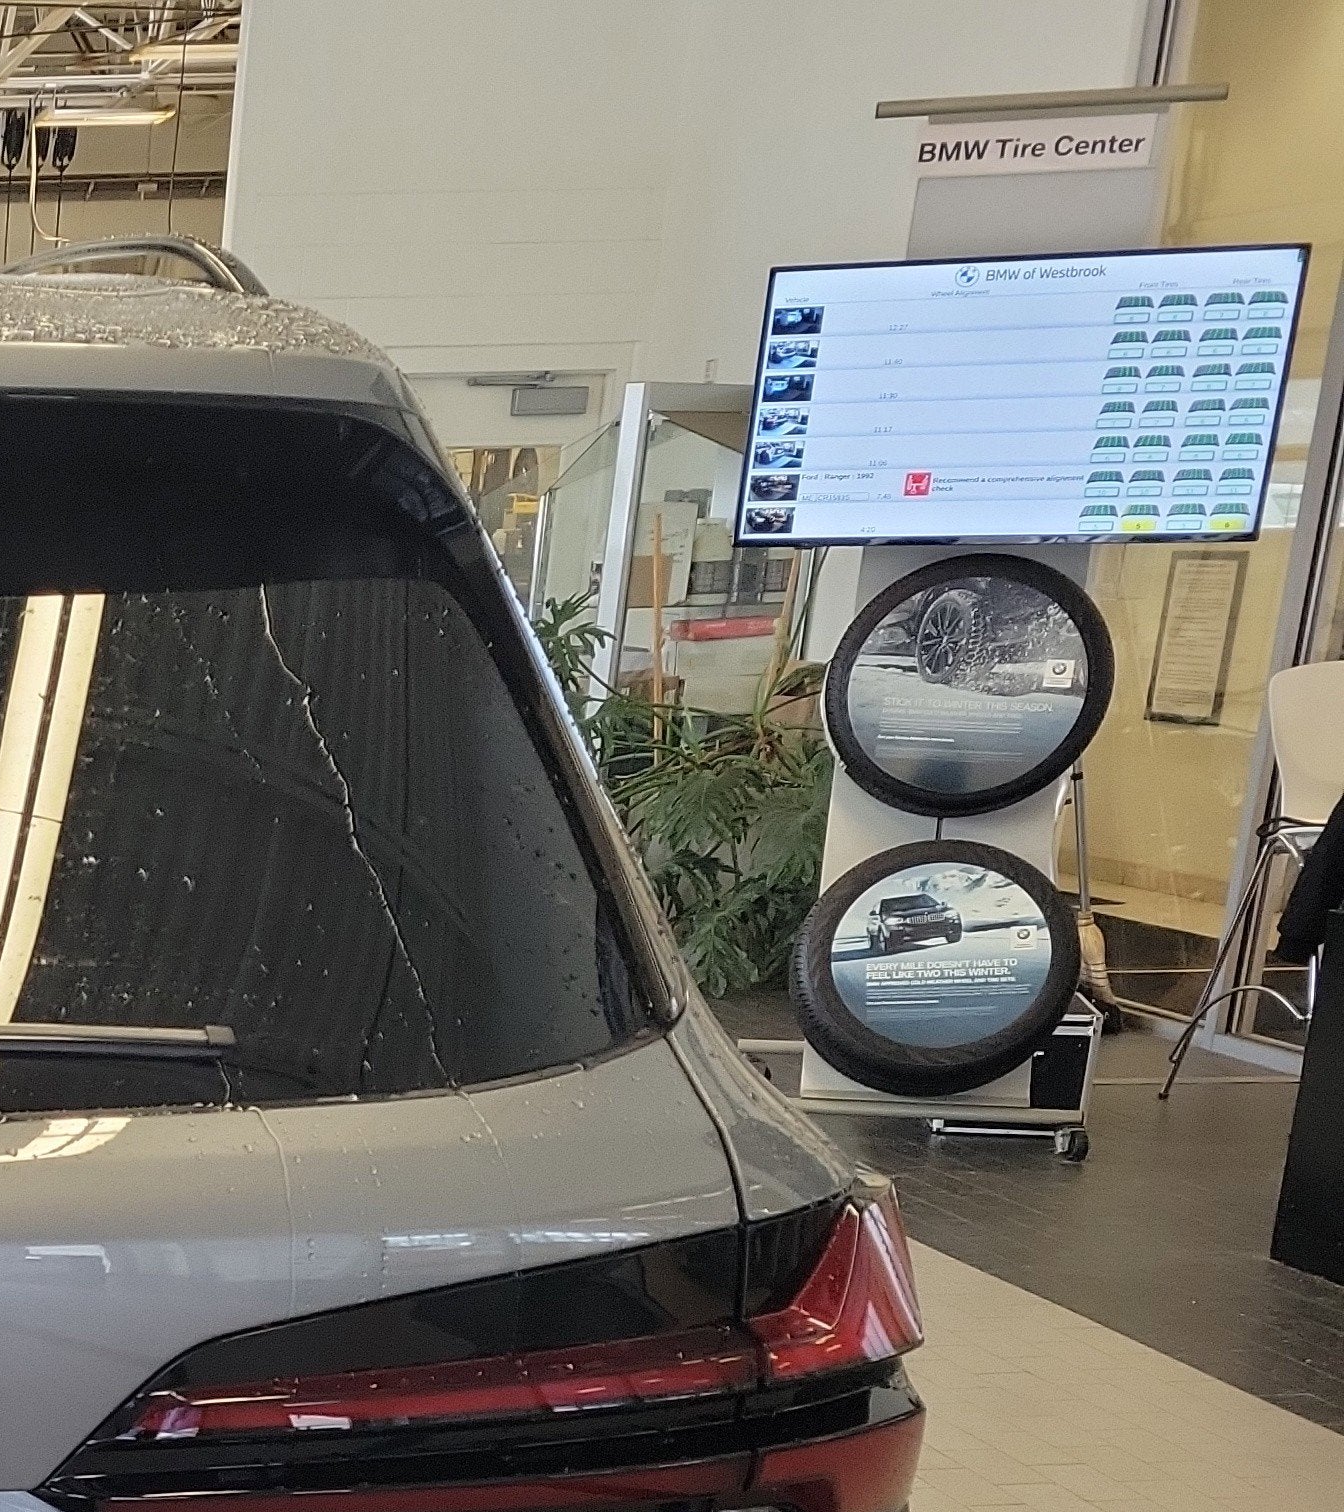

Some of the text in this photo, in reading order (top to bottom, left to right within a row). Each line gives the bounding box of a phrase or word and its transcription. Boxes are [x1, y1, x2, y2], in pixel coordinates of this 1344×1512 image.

[918, 134, 1146, 163] BMW Tire Center
[986, 264, 1108, 282] BMW of Westbrook
[802, 472, 874, 482] Ford Ranger 1992
[933, 475, 980, 484] Recommend
[987, 475, 1046, 484] comprehensive
[1046, 473, 1085, 484] alignment
[884, 697, 911, 707] STICK
[943, 700, 981, 710] WINTER
[986, 702, 1008, 711] THIS
[866, 958, 1018, 972] EVERY MILE DOESN'T HAVE TO
[866, 967, 1012, 980] FEEL LIKE TWO THIS WINTER.
